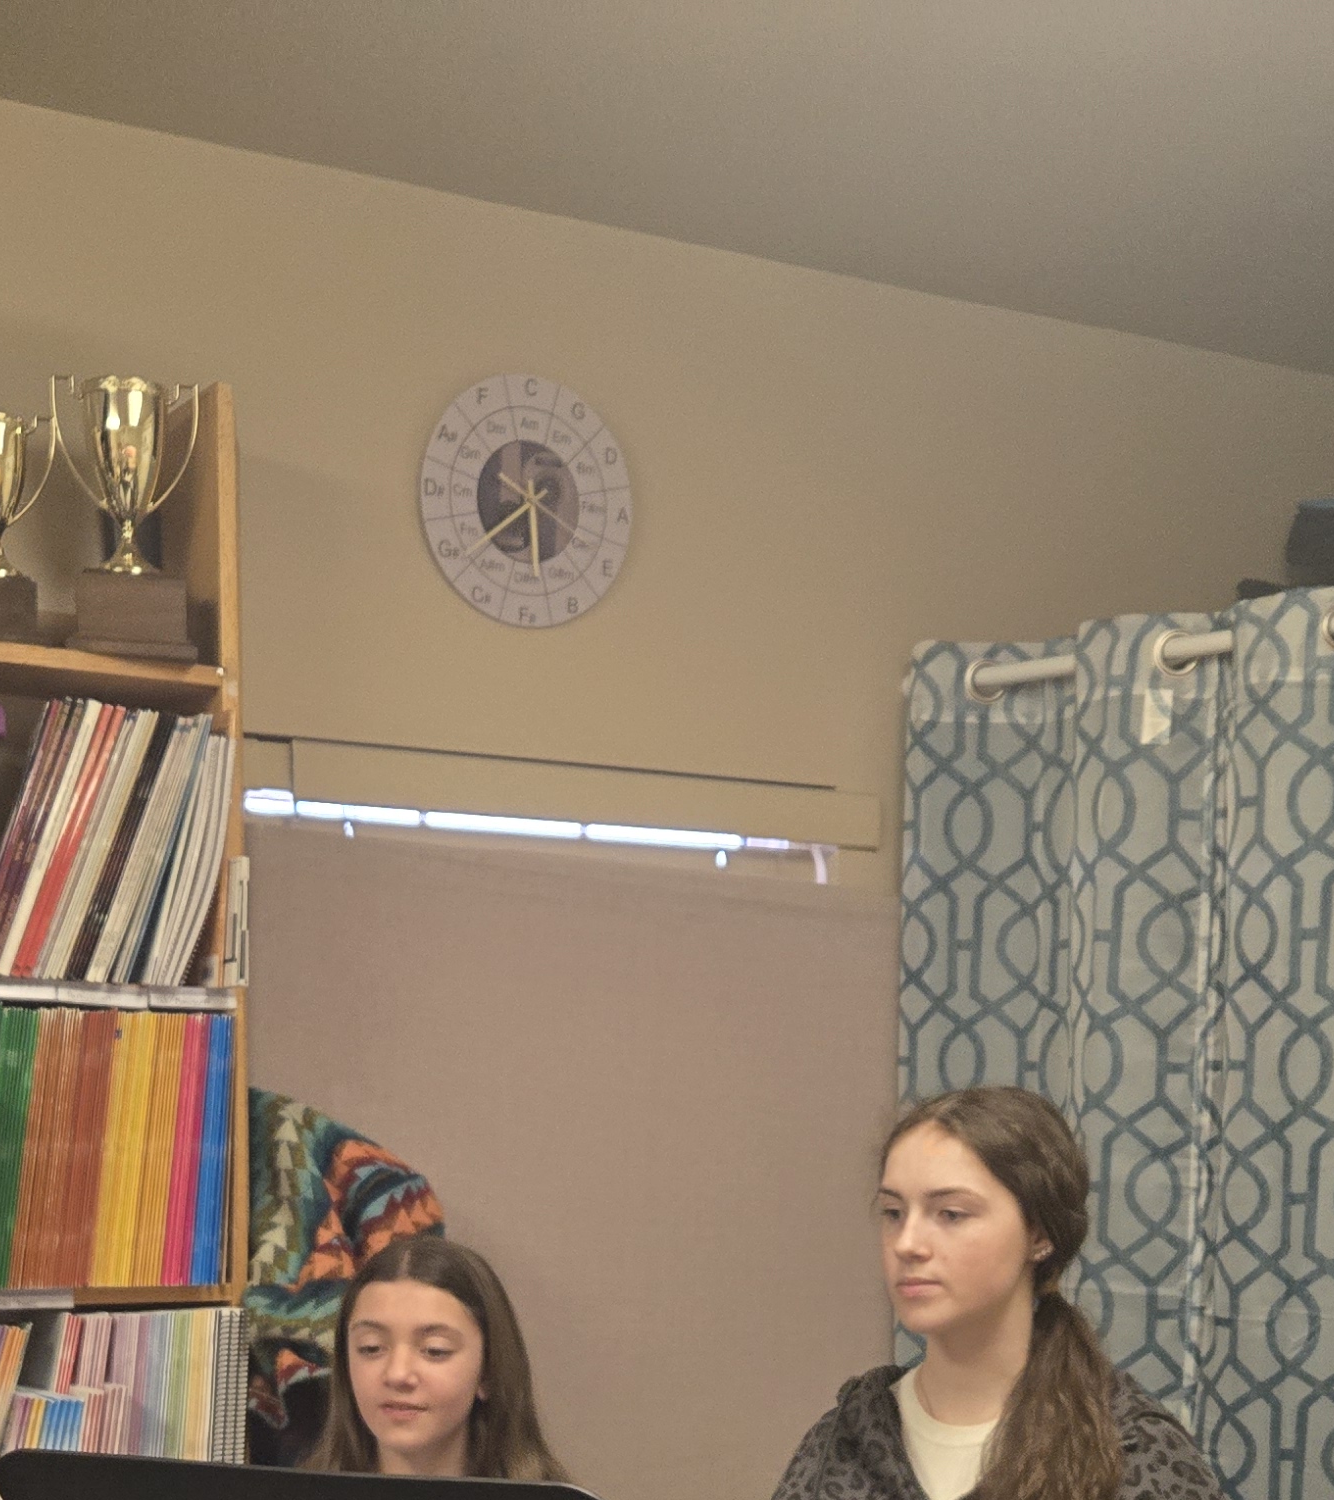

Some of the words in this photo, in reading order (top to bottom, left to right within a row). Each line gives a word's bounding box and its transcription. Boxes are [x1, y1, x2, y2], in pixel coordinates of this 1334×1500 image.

[476, 387, 489, 405] F
[525, 378, 538, 397] C
[571, 402, 586, 421] G
[605, 447, 618, 466] D
[617, 506, 629, 525] A
[602, 559, 614, 577] E
[567, 596, 579, 615] B
